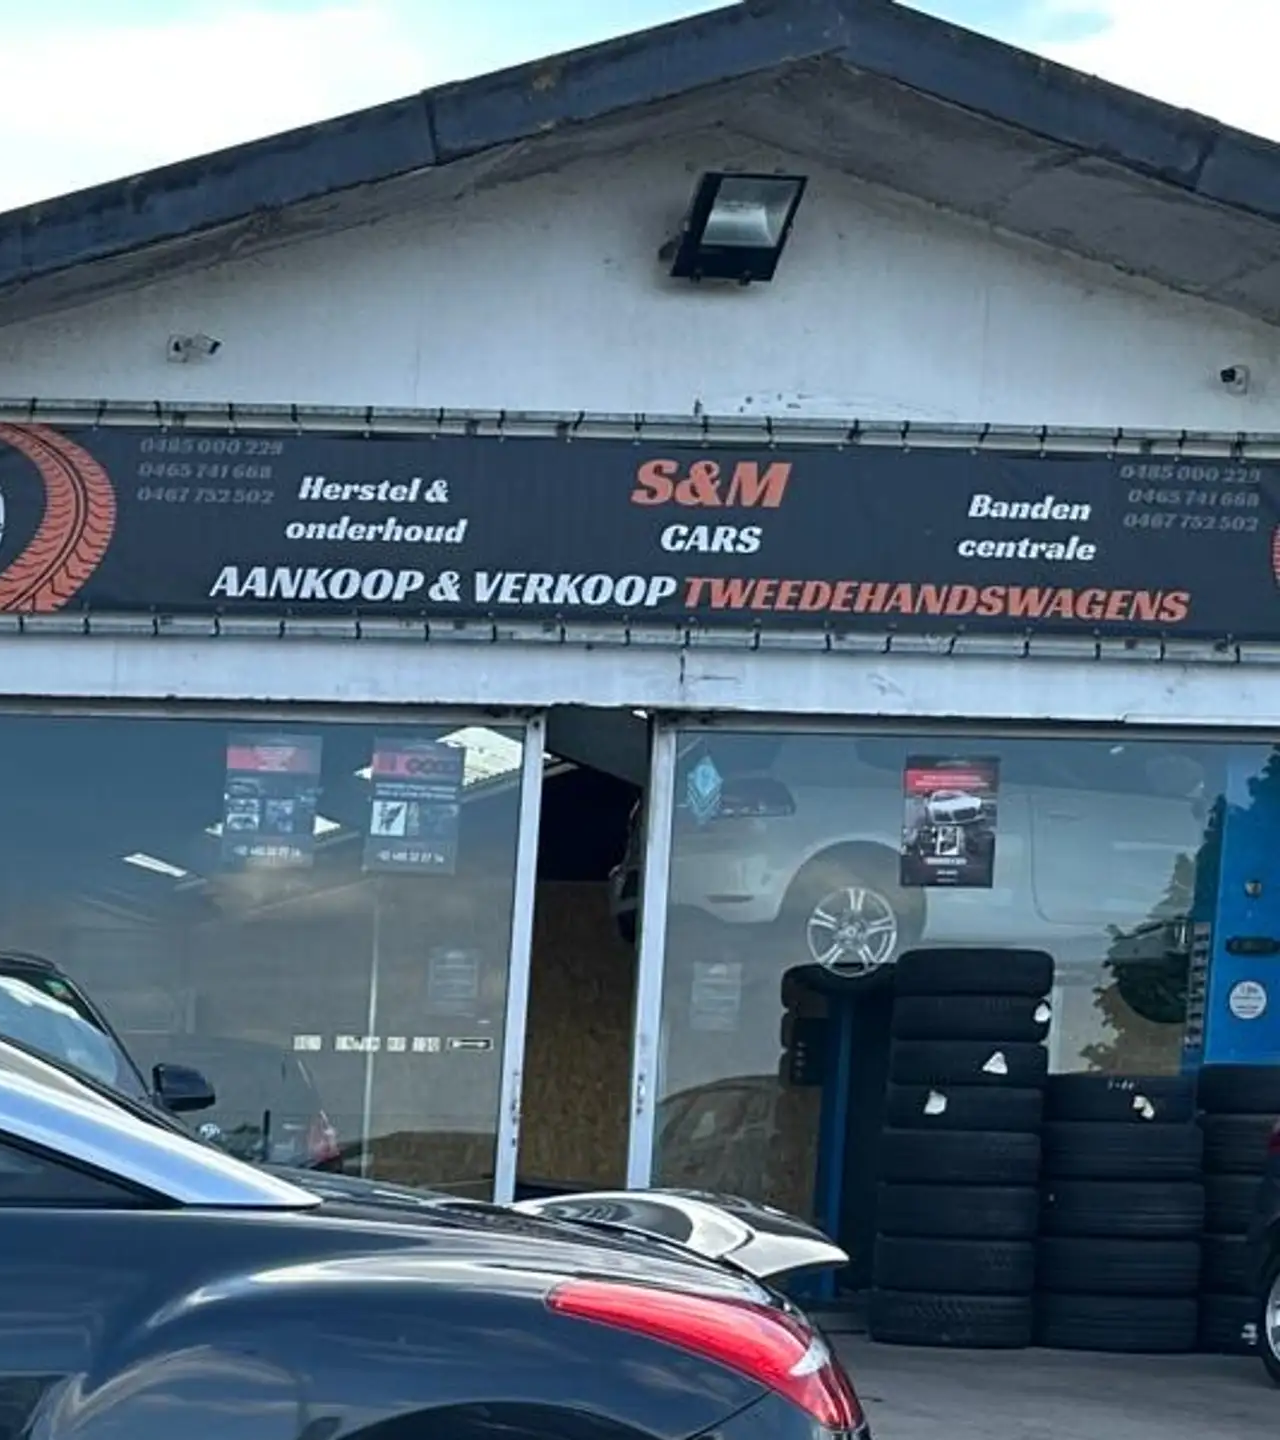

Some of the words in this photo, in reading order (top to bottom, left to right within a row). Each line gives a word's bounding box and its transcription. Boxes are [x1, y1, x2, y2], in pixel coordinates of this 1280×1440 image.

[298, 475, 423, 503] Herstel
[424, 479, 449, 503] &
[630, 459, 792, 507] S&M
[967, 494, 1092, 521] Banden
[286, 515, 468, 543] onderhoud
[660, 524, 763, 554] CARS
[957, 535, 1097, 562] centrale
[209, 566, 425, 601] AANKOOP
[428, 570, 461, 602] &
[474, 572, 678, 607] VERKOOP
[684, 576, 1191, 623] TWEEDEHANDSWAGENS
